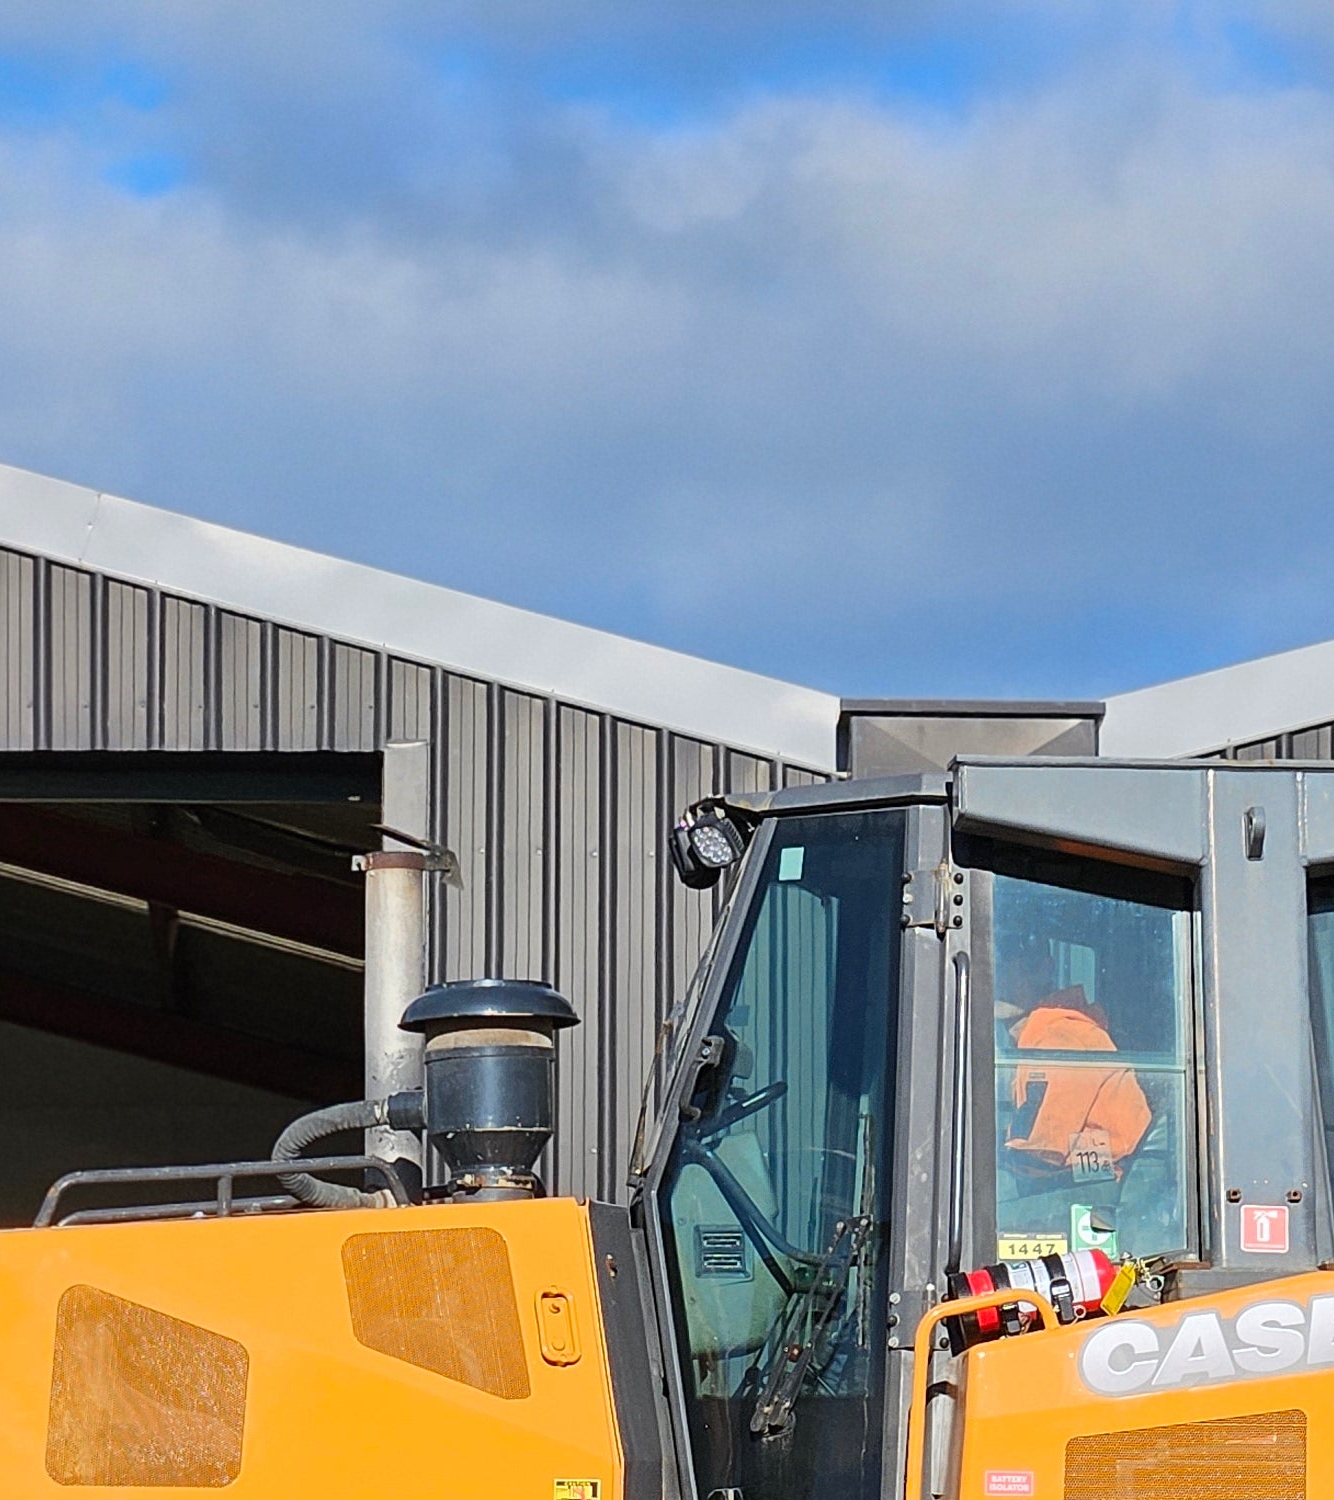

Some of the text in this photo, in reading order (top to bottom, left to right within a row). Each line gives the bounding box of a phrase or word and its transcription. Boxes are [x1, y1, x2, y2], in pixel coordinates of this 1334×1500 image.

[1076, 1151, 1100, 1174] 113
[1008, 1243, 1055, 1255] 1447
[991, 1474, 1028, 1483] BATTERY
[989, 1483, 1030, 1492] ISOLATOR
